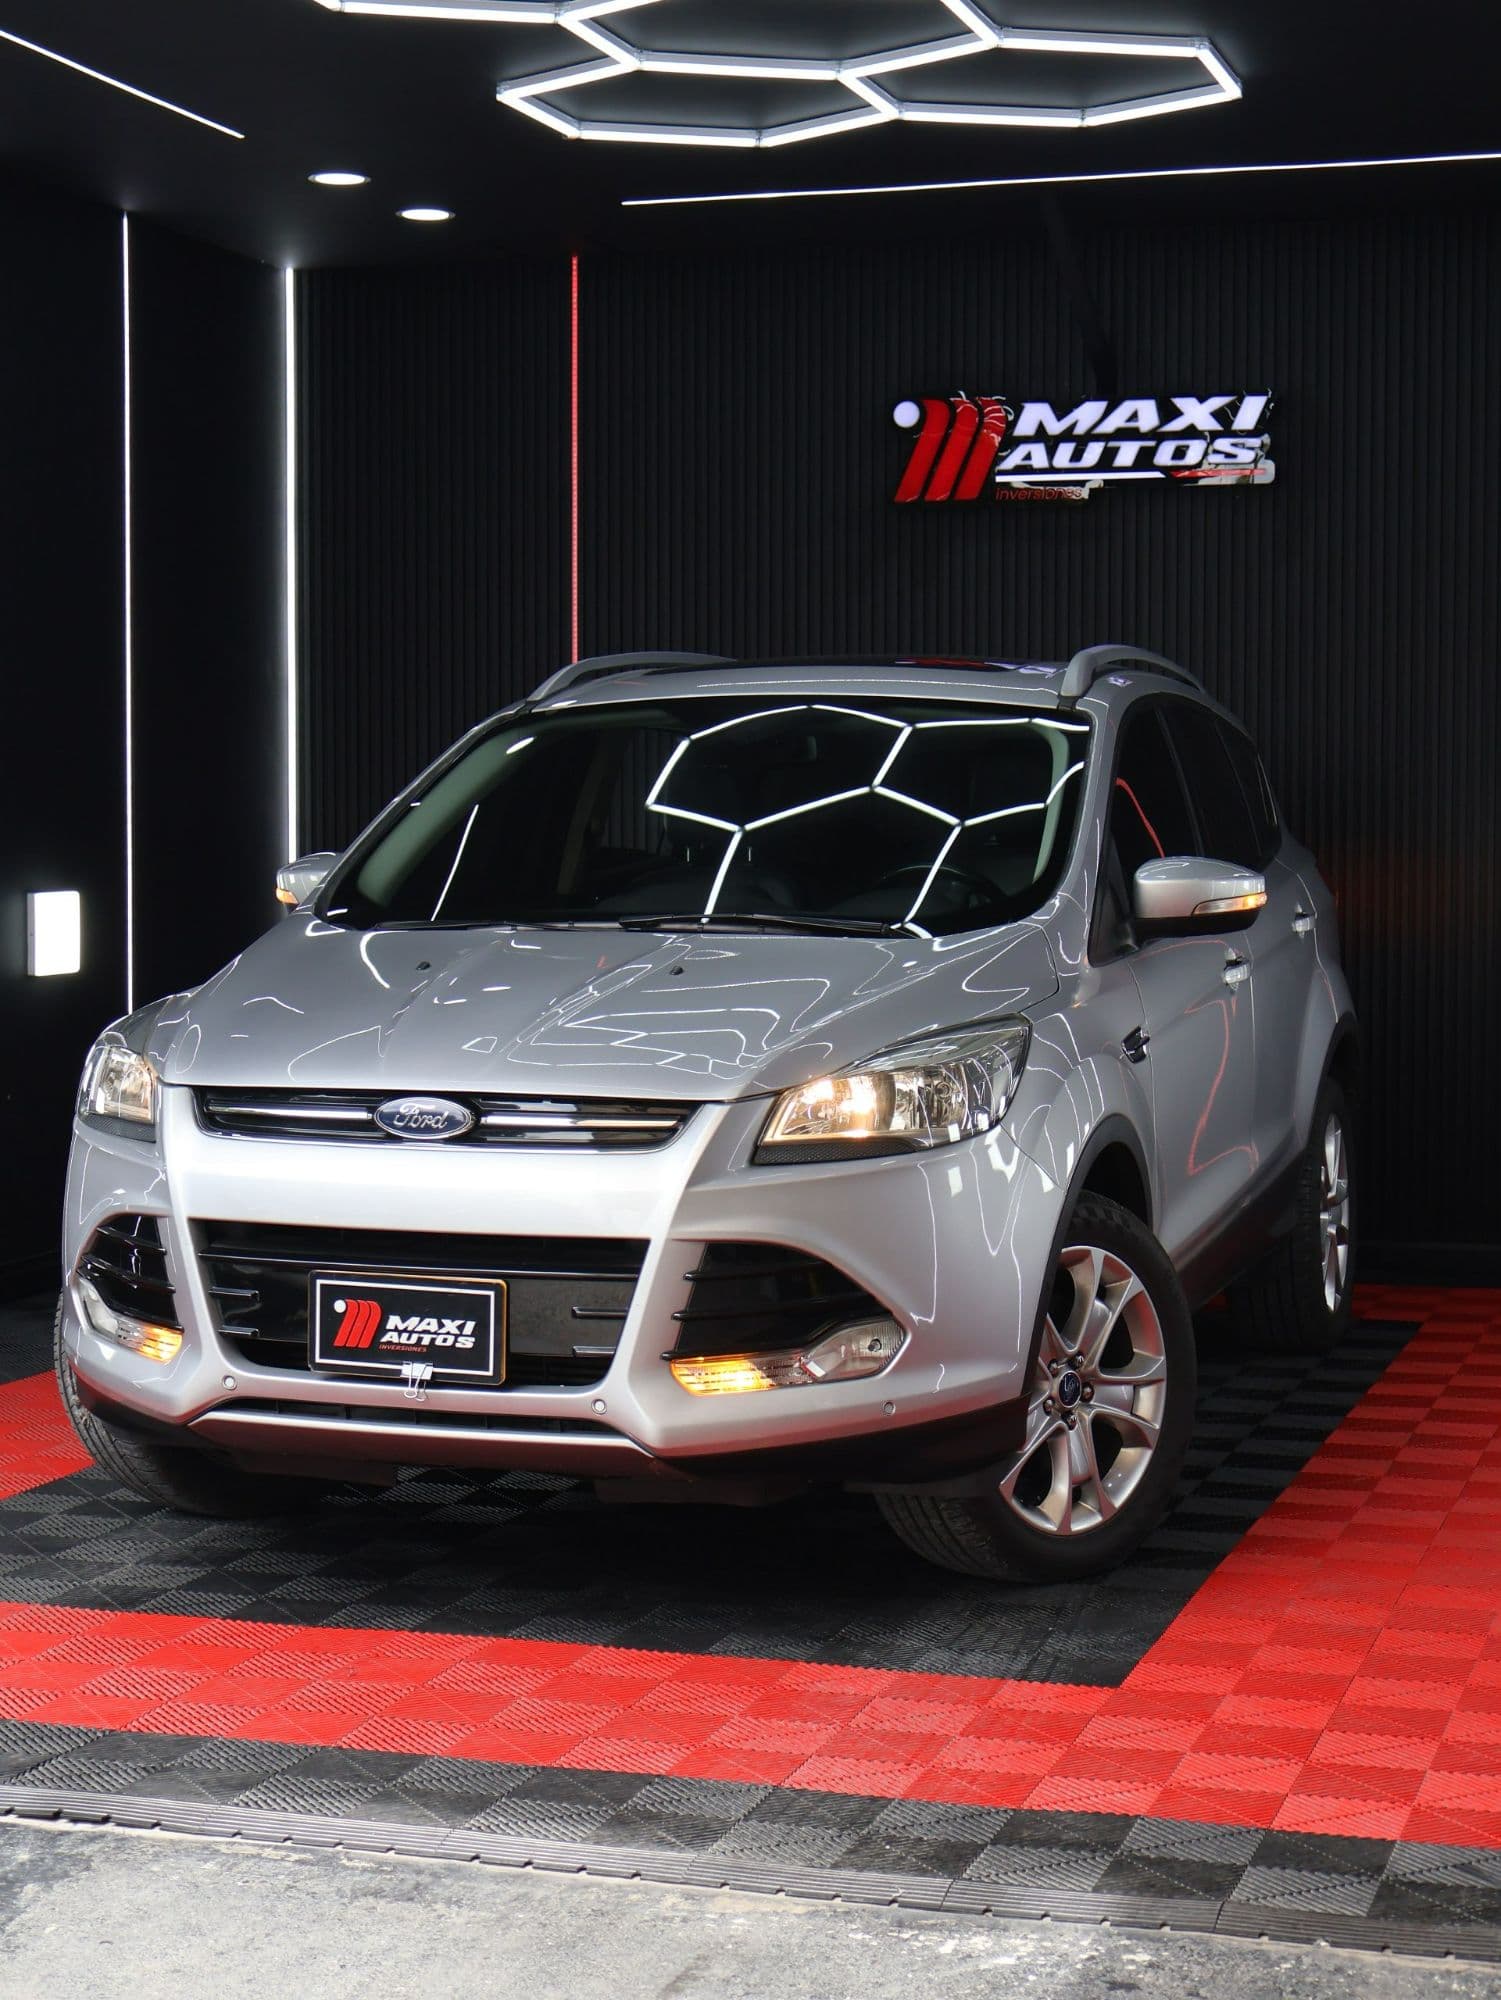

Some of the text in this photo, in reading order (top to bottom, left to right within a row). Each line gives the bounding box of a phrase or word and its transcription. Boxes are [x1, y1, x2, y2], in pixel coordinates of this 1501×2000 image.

[1013, 395, 1268, 436] MAXI
[998, 438, 1262, 470] AUTOS
[392, 1102, 450, 1128] Ford
[385, 1315, 476, 1335] MAXI
[378, 1344, 427, 1352] INVERSIONES
[380, 1332, 476, 1349] AUTOS
